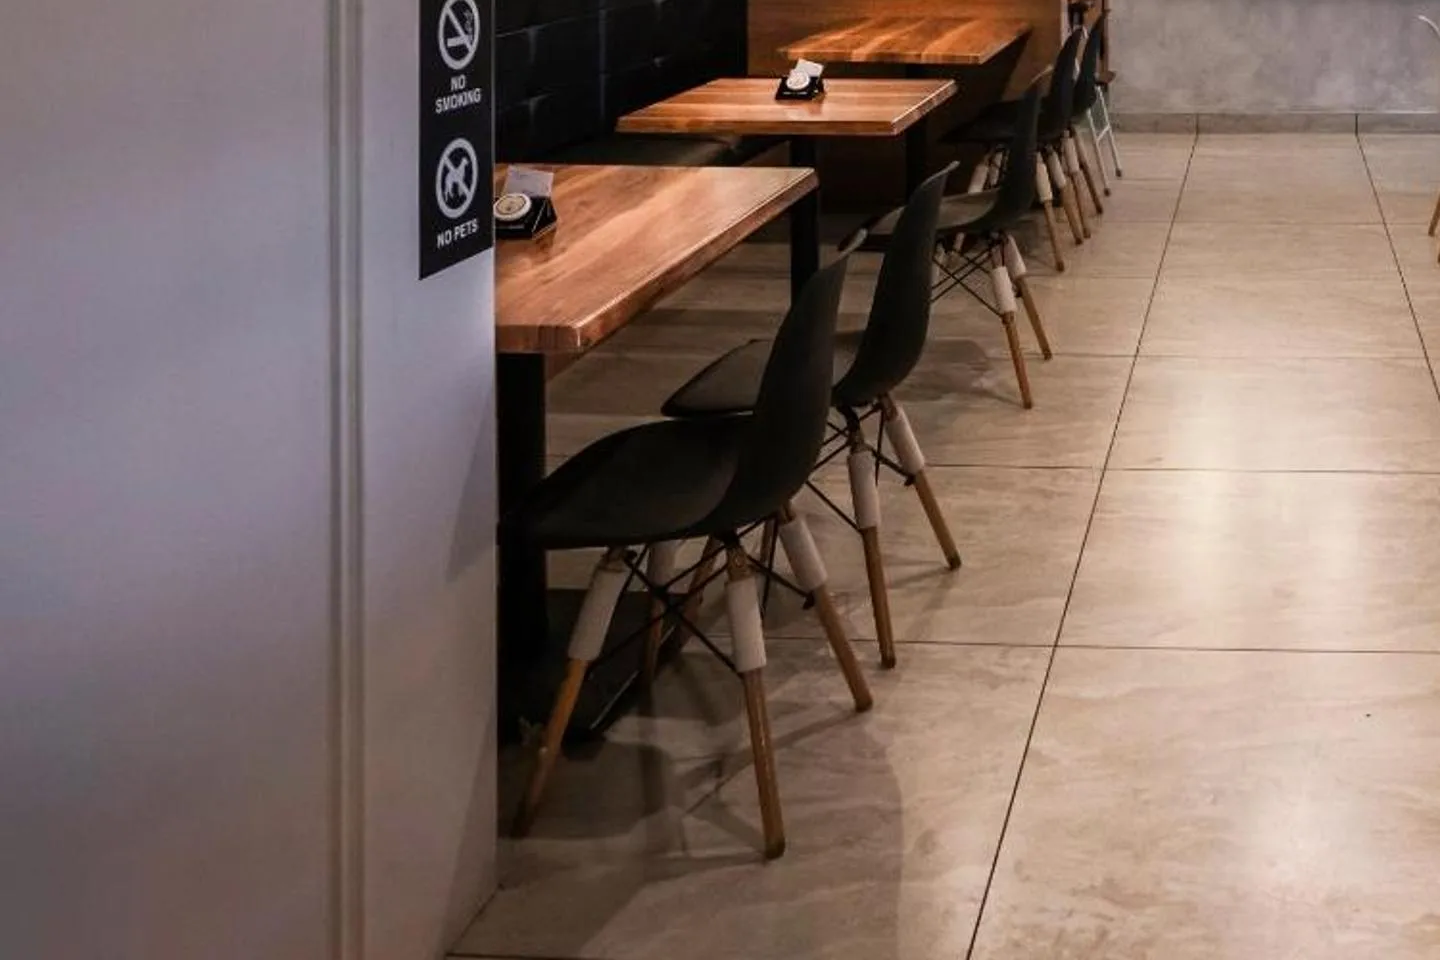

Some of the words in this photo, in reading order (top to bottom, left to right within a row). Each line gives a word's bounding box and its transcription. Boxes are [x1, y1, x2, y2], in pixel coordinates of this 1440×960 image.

[450, 73, 466, 91] NO
[435, 87, 482, 114] SMOKING
[437, 229, 452, 249] NO
[454, 218, 478, 240] PETS
